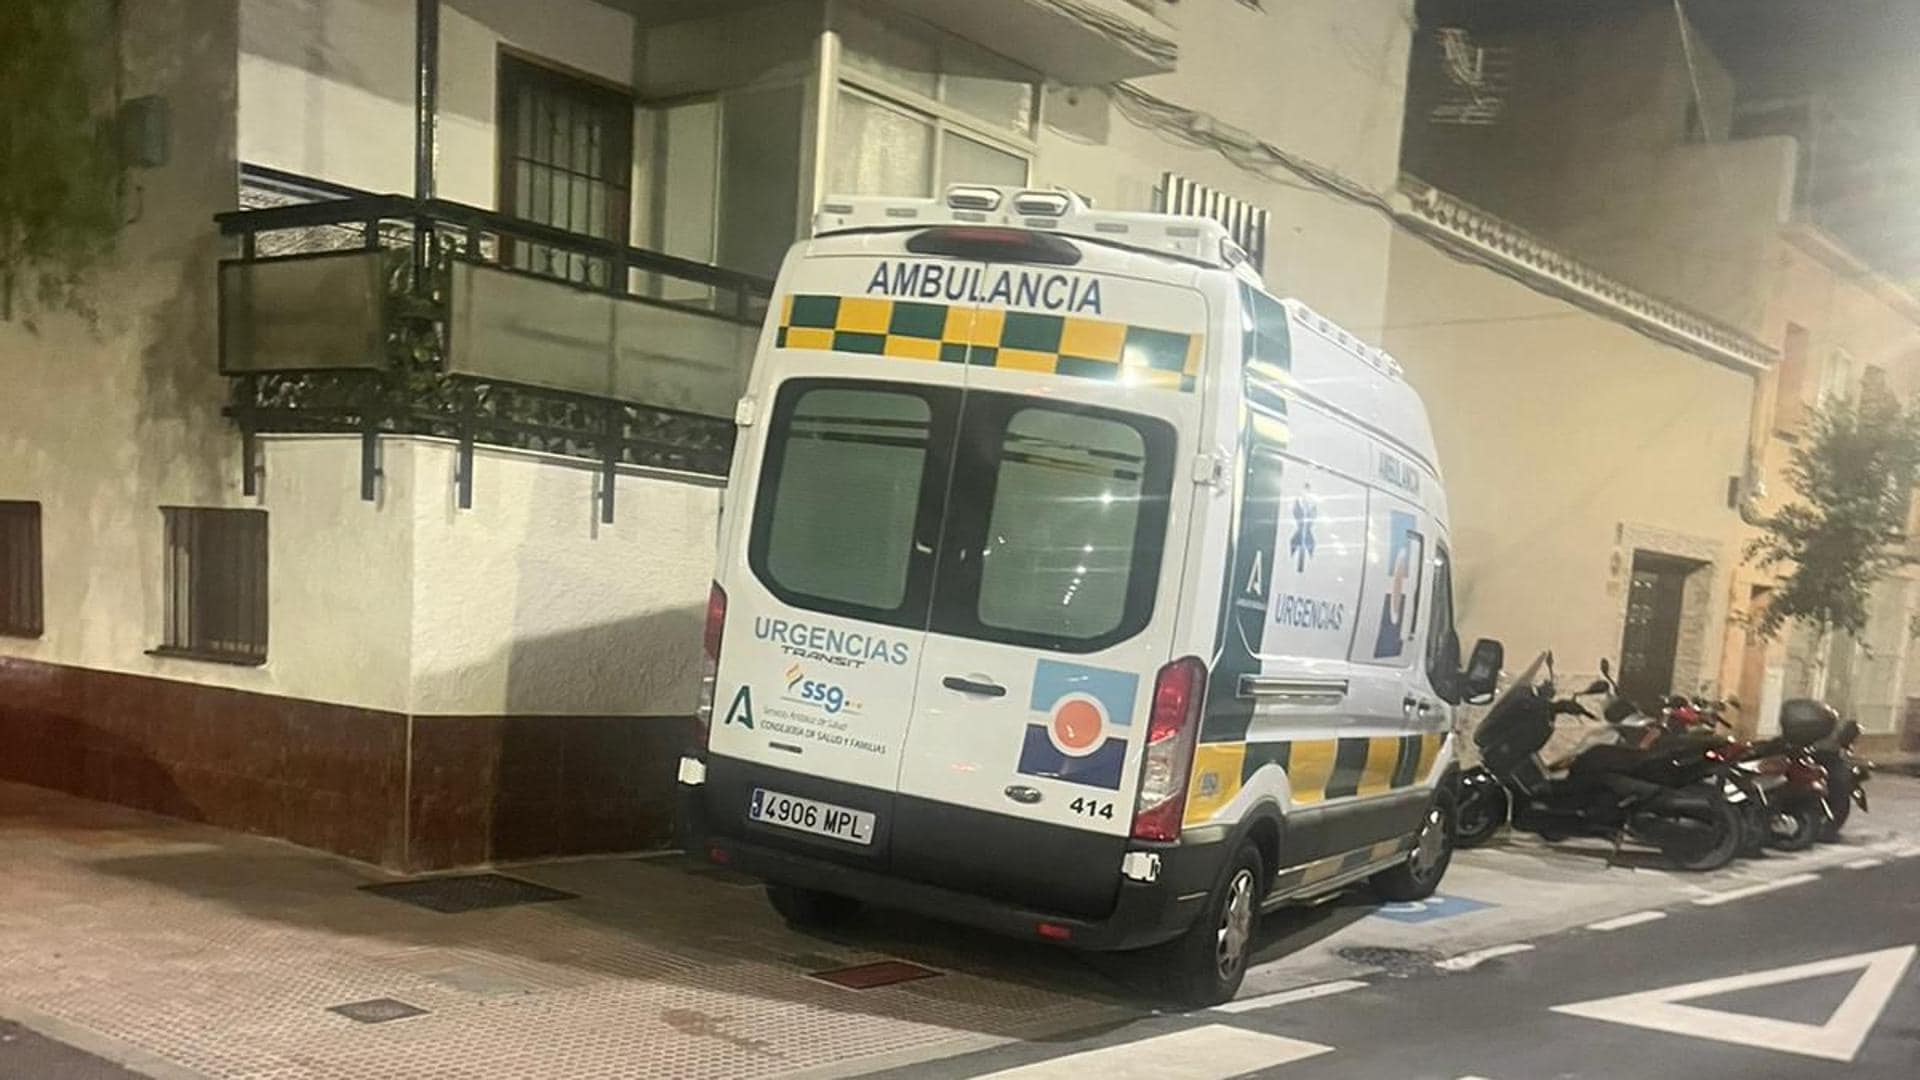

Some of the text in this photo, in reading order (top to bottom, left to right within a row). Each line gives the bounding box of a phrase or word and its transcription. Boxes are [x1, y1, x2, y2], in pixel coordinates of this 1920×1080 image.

[867, 261, 1101, 315] AMBULANCIA
[1276, 594, 1344, 630] URGENCIAS
[755, 617, 909, 665] URGENCIAS
[781, 645, 865, 668] TRANSIT
[765, 796, 862, 839] 4906 MPL
[1070, 798, 1114, 820] 414
